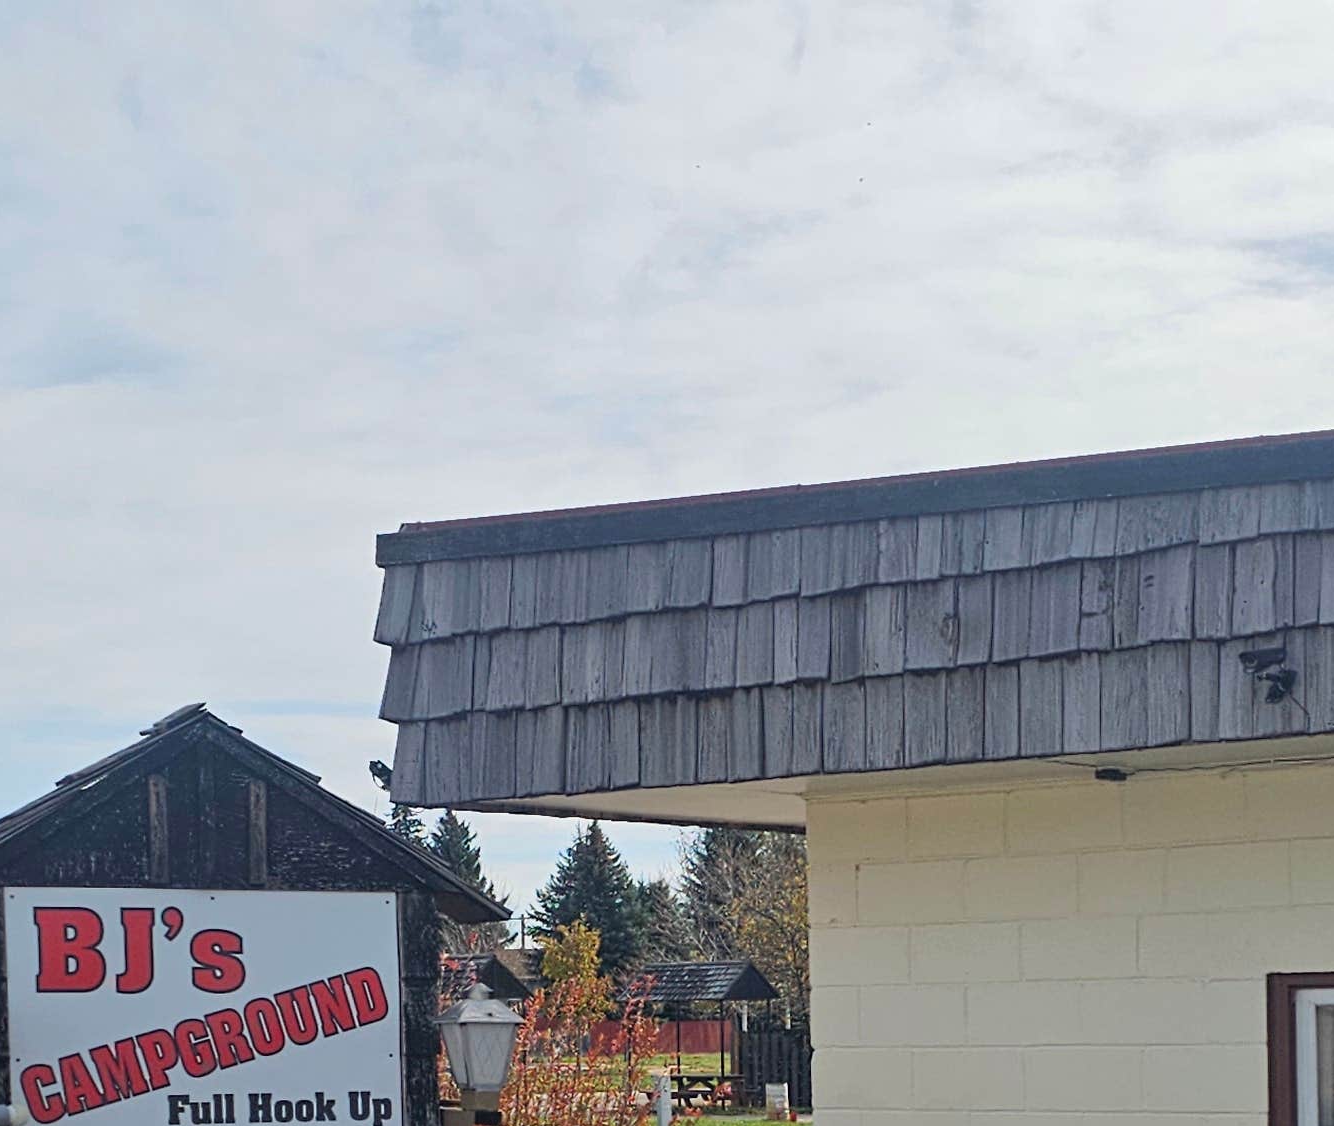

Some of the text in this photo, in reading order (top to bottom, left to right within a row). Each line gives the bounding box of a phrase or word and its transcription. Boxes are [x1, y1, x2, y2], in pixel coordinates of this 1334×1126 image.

[33, 906, 246, 994] BJ's
[20, 966, 389, 1124] CAMPGROUND
[167, 1091, 392, 1126] Full Hook Up
